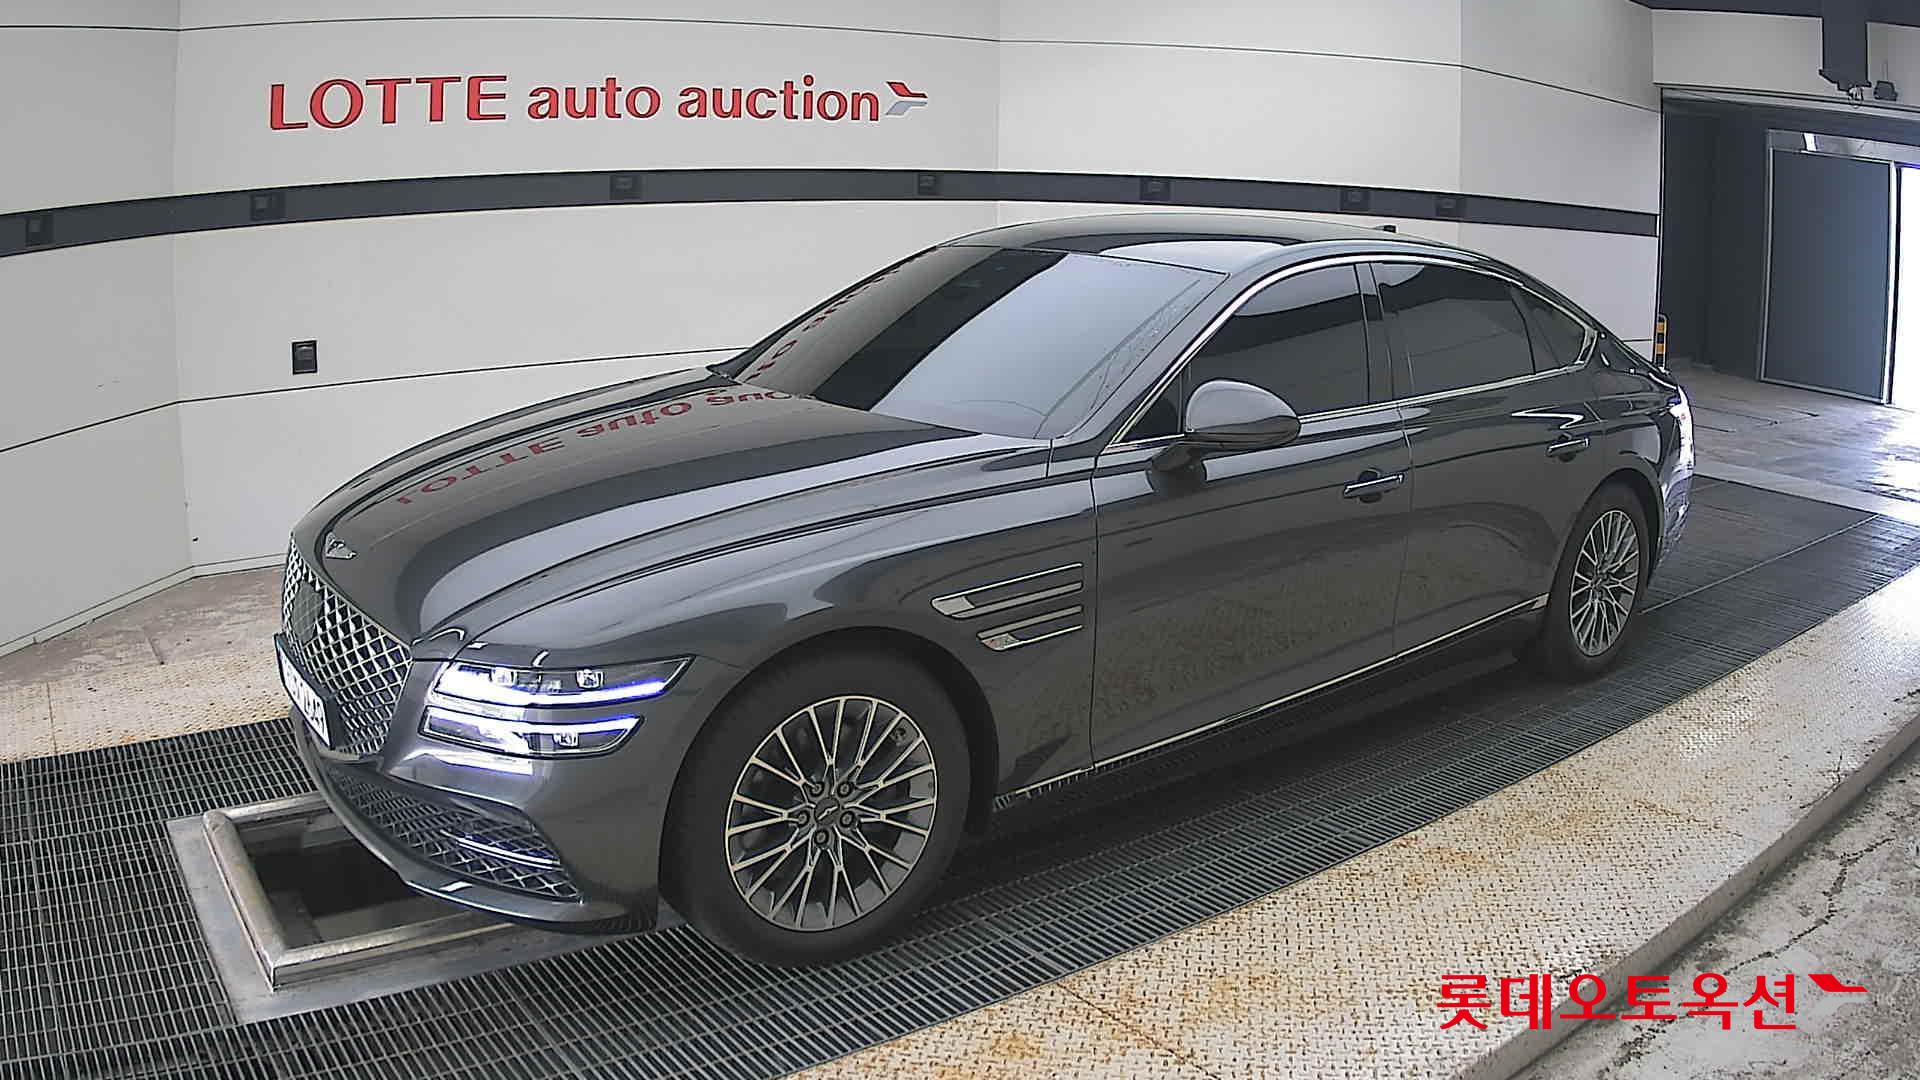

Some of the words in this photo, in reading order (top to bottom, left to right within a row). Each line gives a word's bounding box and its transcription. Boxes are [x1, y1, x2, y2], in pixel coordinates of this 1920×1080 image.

[269, 74, 507, 130] LOTTE
[528, 77, 661, 120] auto
[678, 75, 880, 121] auction
